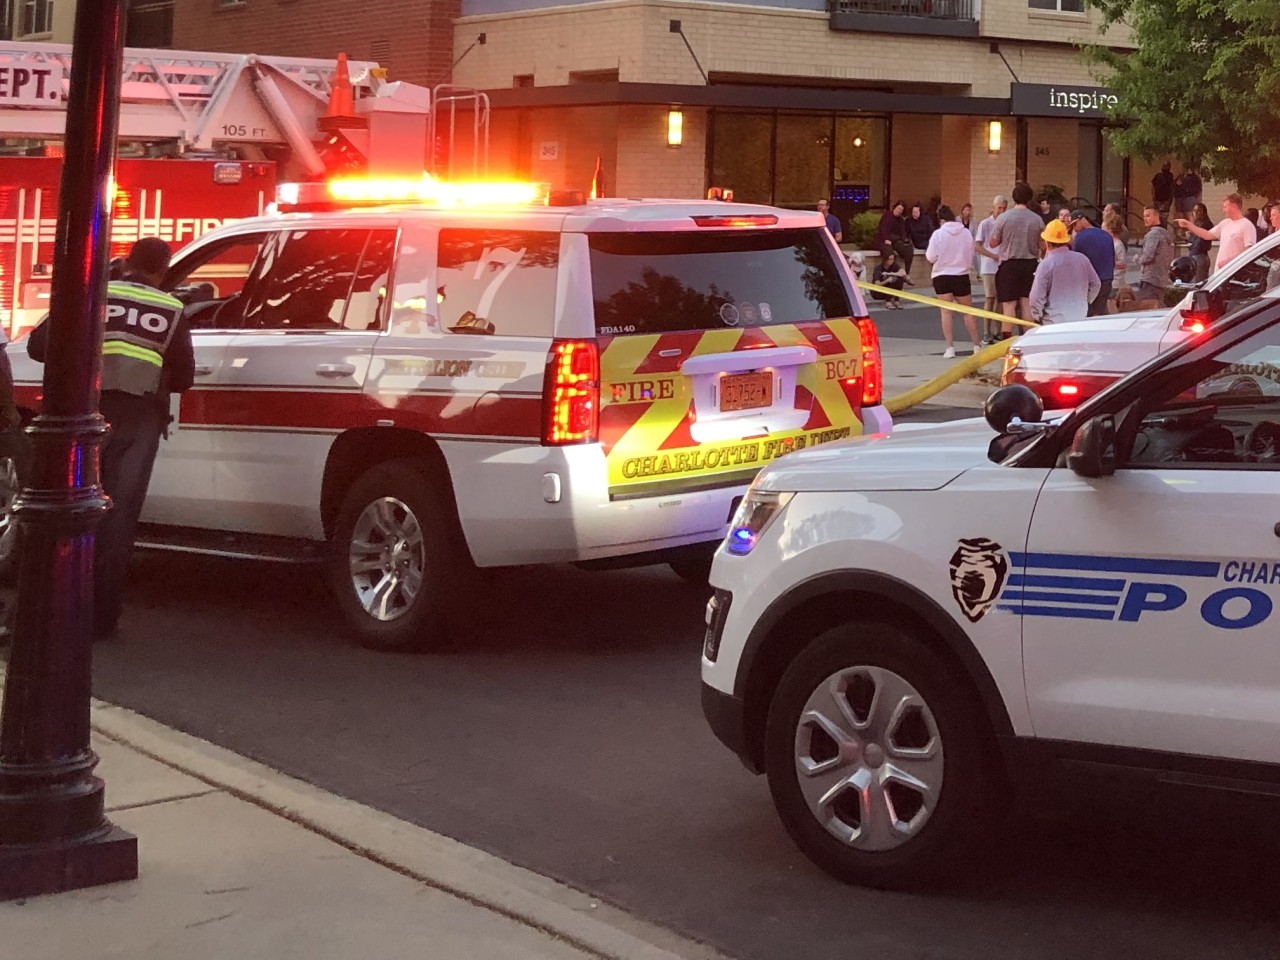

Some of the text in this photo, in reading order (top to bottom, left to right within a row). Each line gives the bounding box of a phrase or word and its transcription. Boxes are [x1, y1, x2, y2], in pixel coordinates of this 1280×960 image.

[1049, 88, 1119, 113] inspire
[222, 124, 247, 137] 105
[1034, 147, 1050, 157] 345
[104, 304, 168, 333] PIO
[825, 359, 858, 381] BC-7
[609, 379, 675, 404] FIRE
[621, 442, 760, 479] CHARLOTTE
[762, 433, 807, 461] FIRE
